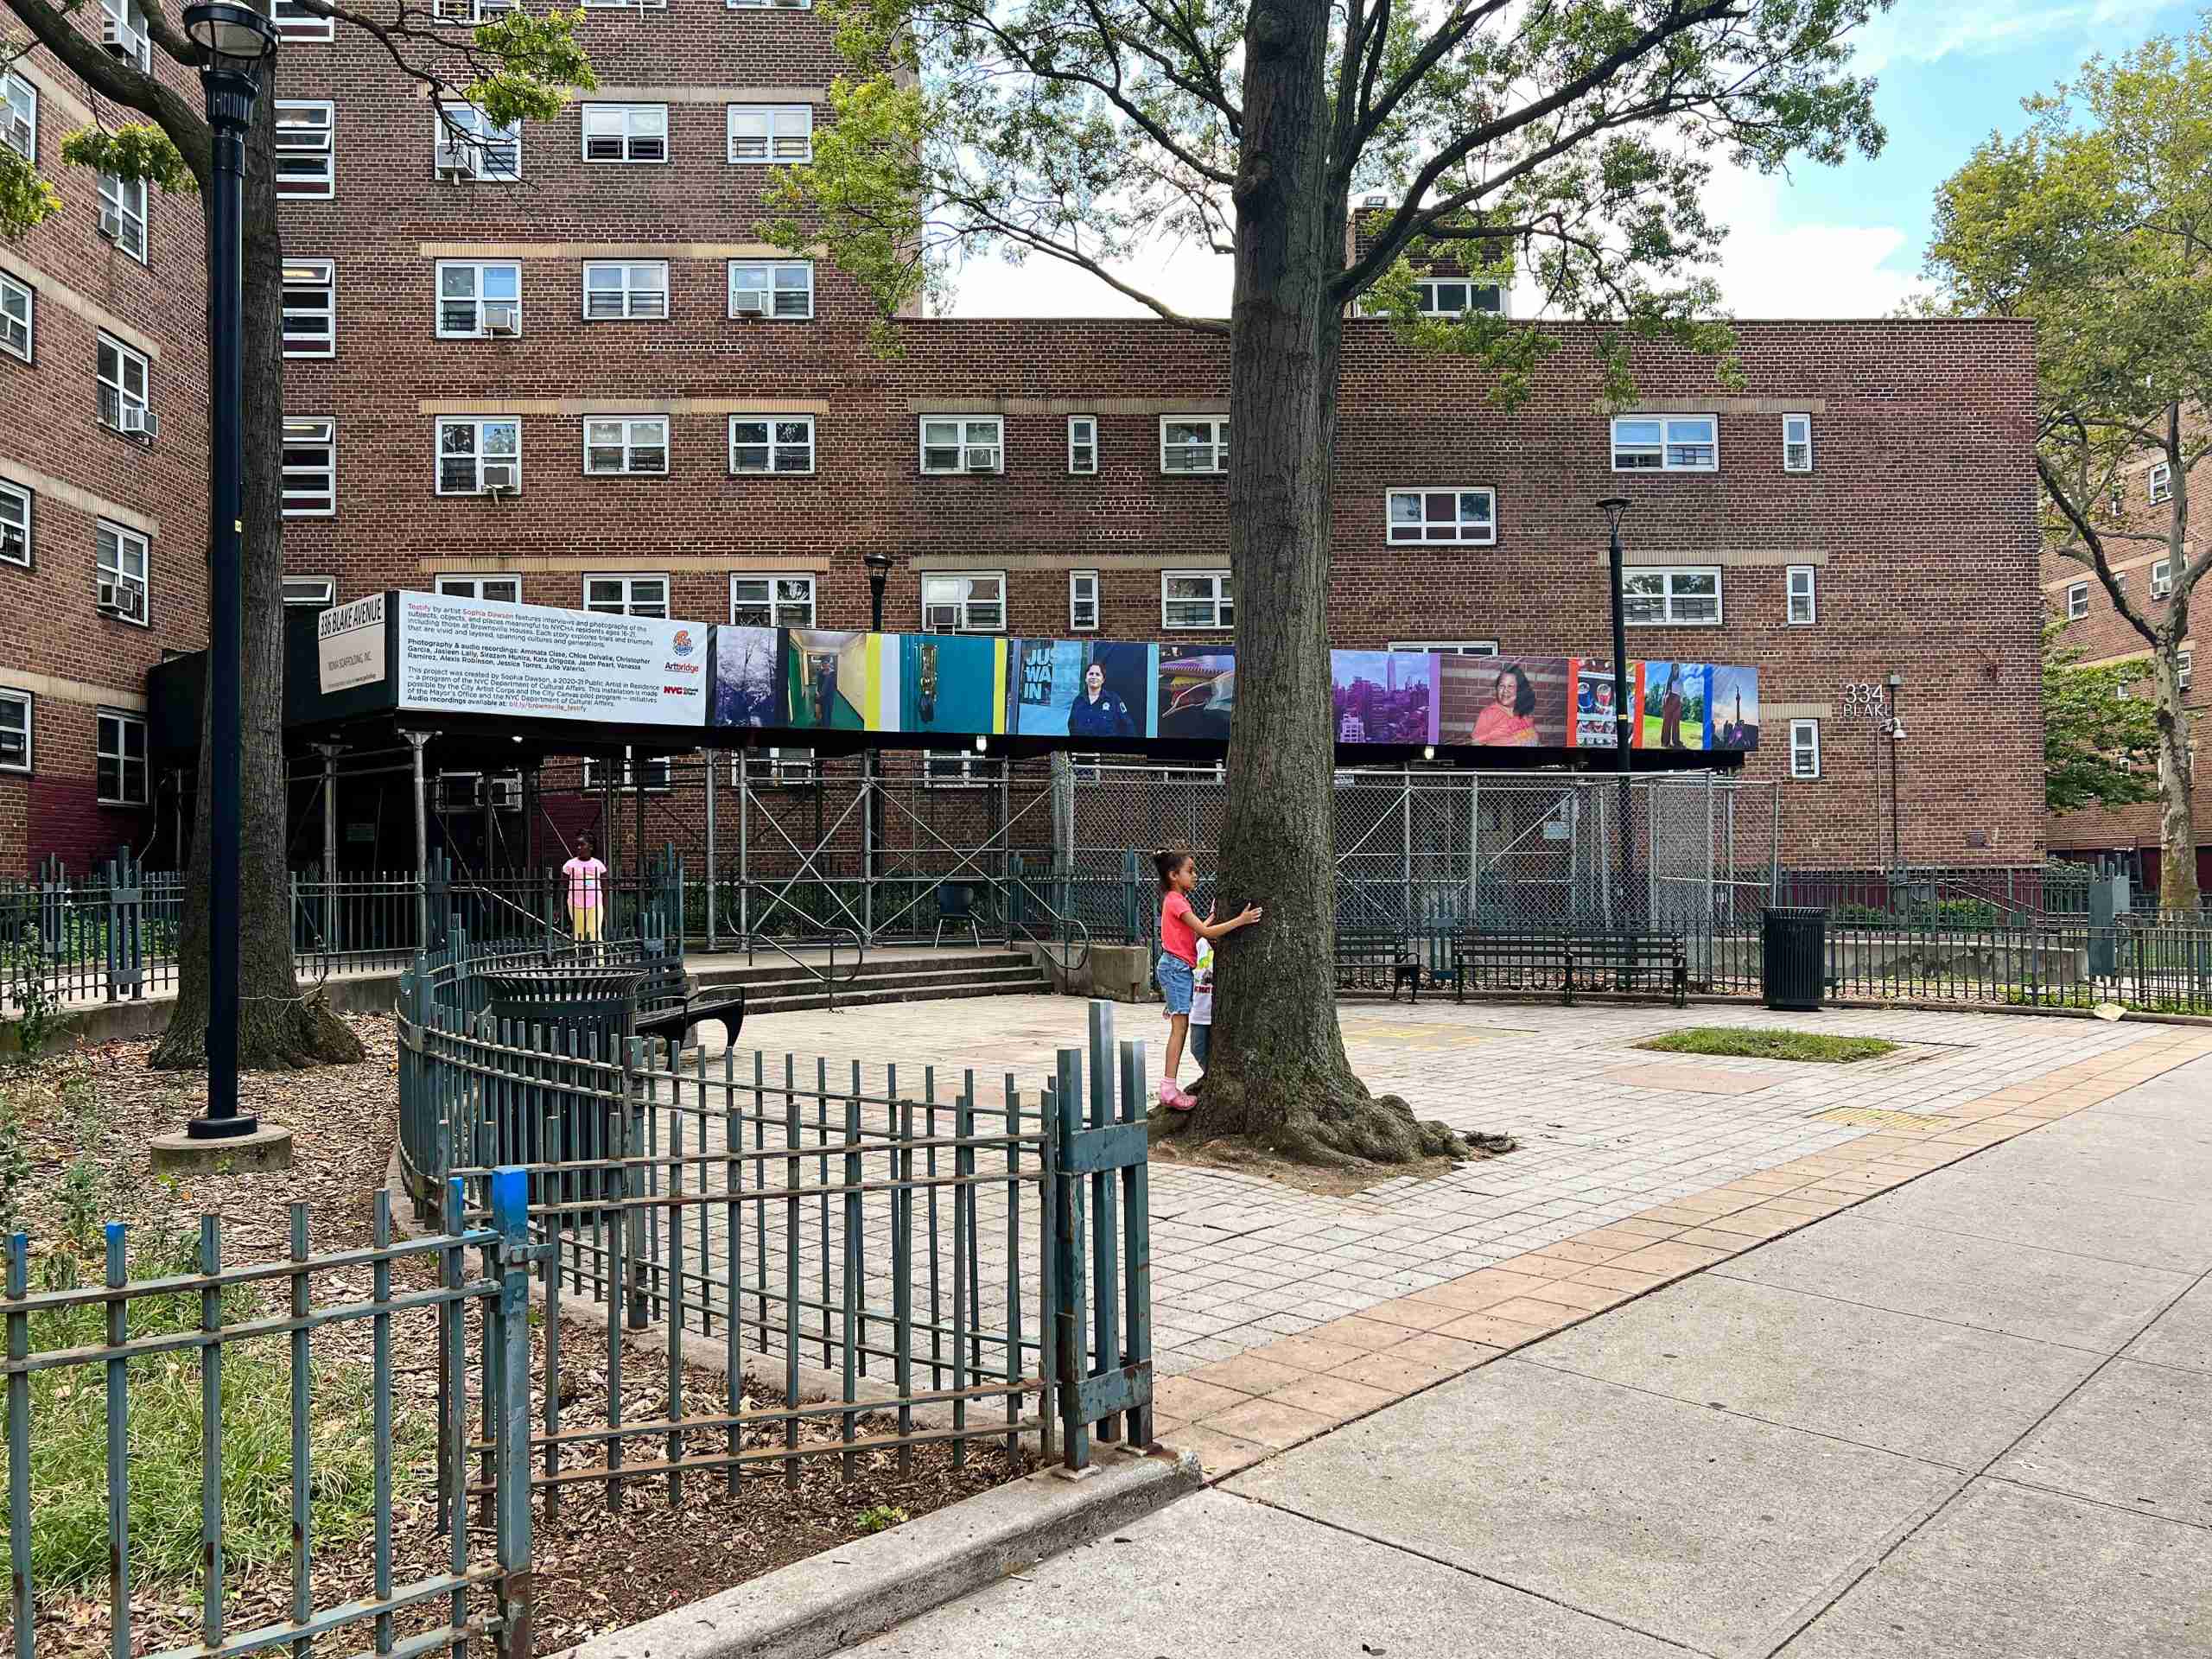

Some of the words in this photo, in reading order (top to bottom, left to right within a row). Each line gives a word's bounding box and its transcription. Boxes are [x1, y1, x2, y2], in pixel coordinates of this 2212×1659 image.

[332, 607, 353, 632] BLAKE
[353, 597, 382, 626] AVENUE
[408, 603, 429, 612] Testify
[487, 611, 513, 620] Dawson
[589, 621, 627, 631] photographs
[408, 618, 439, 626] including
[470, 623, 507, 632] Brownsville
[505, 620, 540, 629] meaningful
[497, 632, 525, 641] spanning
[408, 639, 452, 648] Photography
[615, 656, 650, 664] Christopher
[664, 685, 683, 695] NYC
[1024, 683, 1042, 700] IN
[1846, 683, 1885, 703] 334
